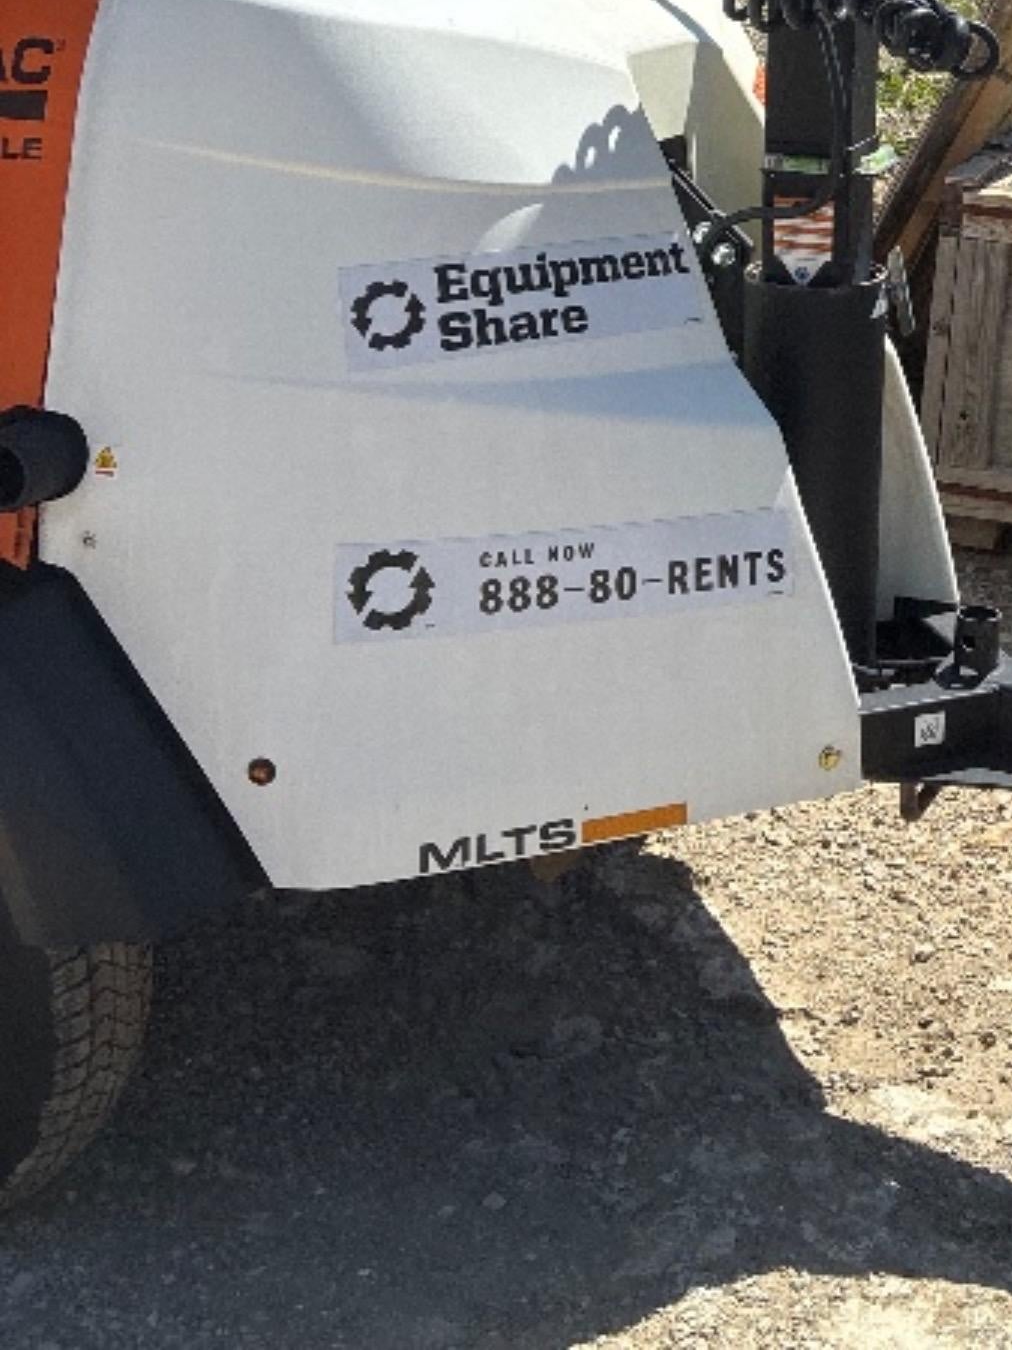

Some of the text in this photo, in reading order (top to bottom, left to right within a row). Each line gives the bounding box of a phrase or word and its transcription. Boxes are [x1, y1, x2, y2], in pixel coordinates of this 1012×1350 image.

[0, 37, 54, 84] C
[433, 242, 691, 306] Equipment
[438, 305, 589, 351] Share
[479, 543, 596, 568] CALL NOW
[479, 548, 787, 615] 888-80-RENTS
[419, 818, 577, 874] MLTS
